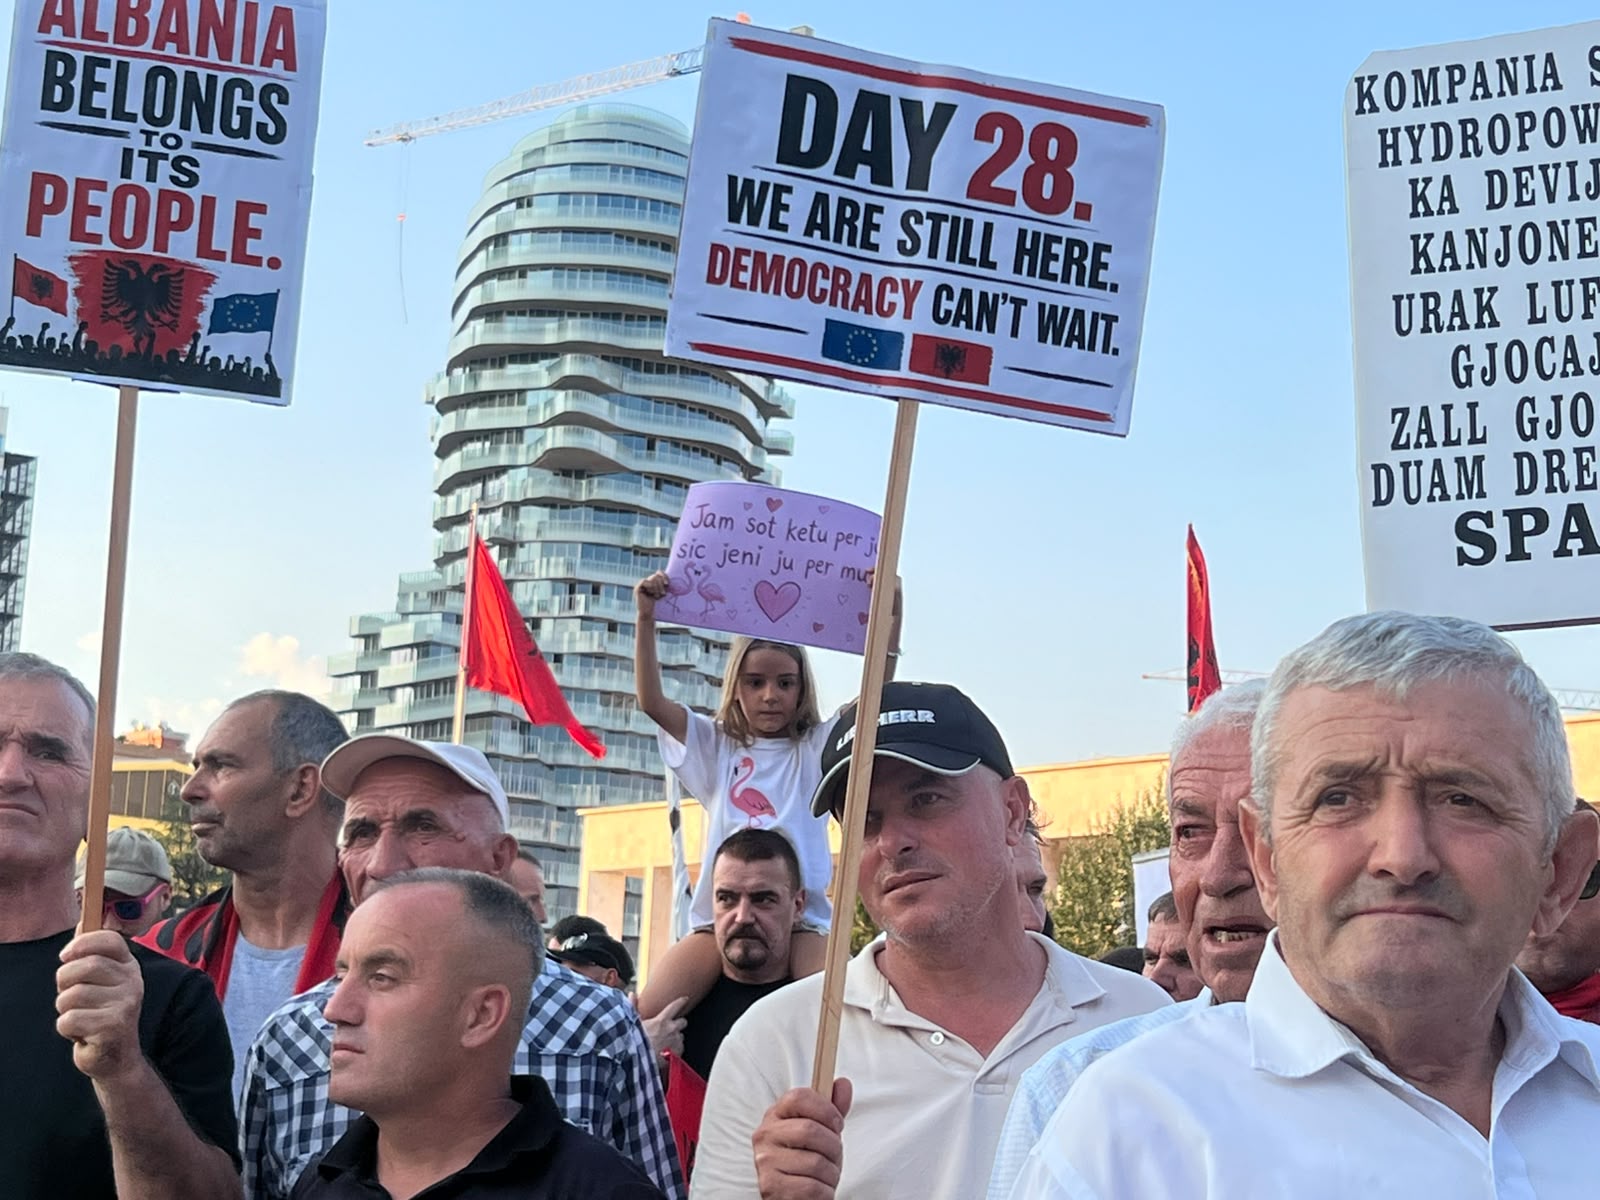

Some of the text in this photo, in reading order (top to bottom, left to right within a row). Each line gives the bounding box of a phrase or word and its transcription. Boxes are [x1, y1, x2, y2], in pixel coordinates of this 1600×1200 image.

[38, 0, 297, 72] ALBANIA
[40, 50, 290, 144] BELONGS
[1354, 52, 1563, 115] KOMPANIA
[140, 130, 182, 150] TO
[776, 74, 1093, 222] DAY 28.
[1378, 102, 1600, 168] HYDROPOW
[120, 148, 200, 188] ITS
[1408, 158, 1600, 218] KA DEVIJ
[26, 172, 282, 270] PEOPLE.
[727, 174, 1119, 293] WE ARE STILL HERE.
[1410, 216, 1599, 275] KANJONE
[706, 243, 1120, 356] DEMOCRACY CAN'T WAIT.
[1392, 286, 1500, 336] URAK
[1451, 332, 1600, 389] GJOCAJ
[1391, 392, 1594, 451] ZALL GJO
[1371, 446, 1597, 507] DUAM DRE
[691, 503, 734, 530] Jam
[745, 516, 776, 538] sot
[786, 519, 827, 544] ketu
[834, 531, 863, 551] per
[1454, 502, 1600, 566] SPA
[676, 538, 706, 559] sic
[716, 543, 763, 568] jeni
[771, 550, 793, 575] ju
[804, 558, 834, 578] per
